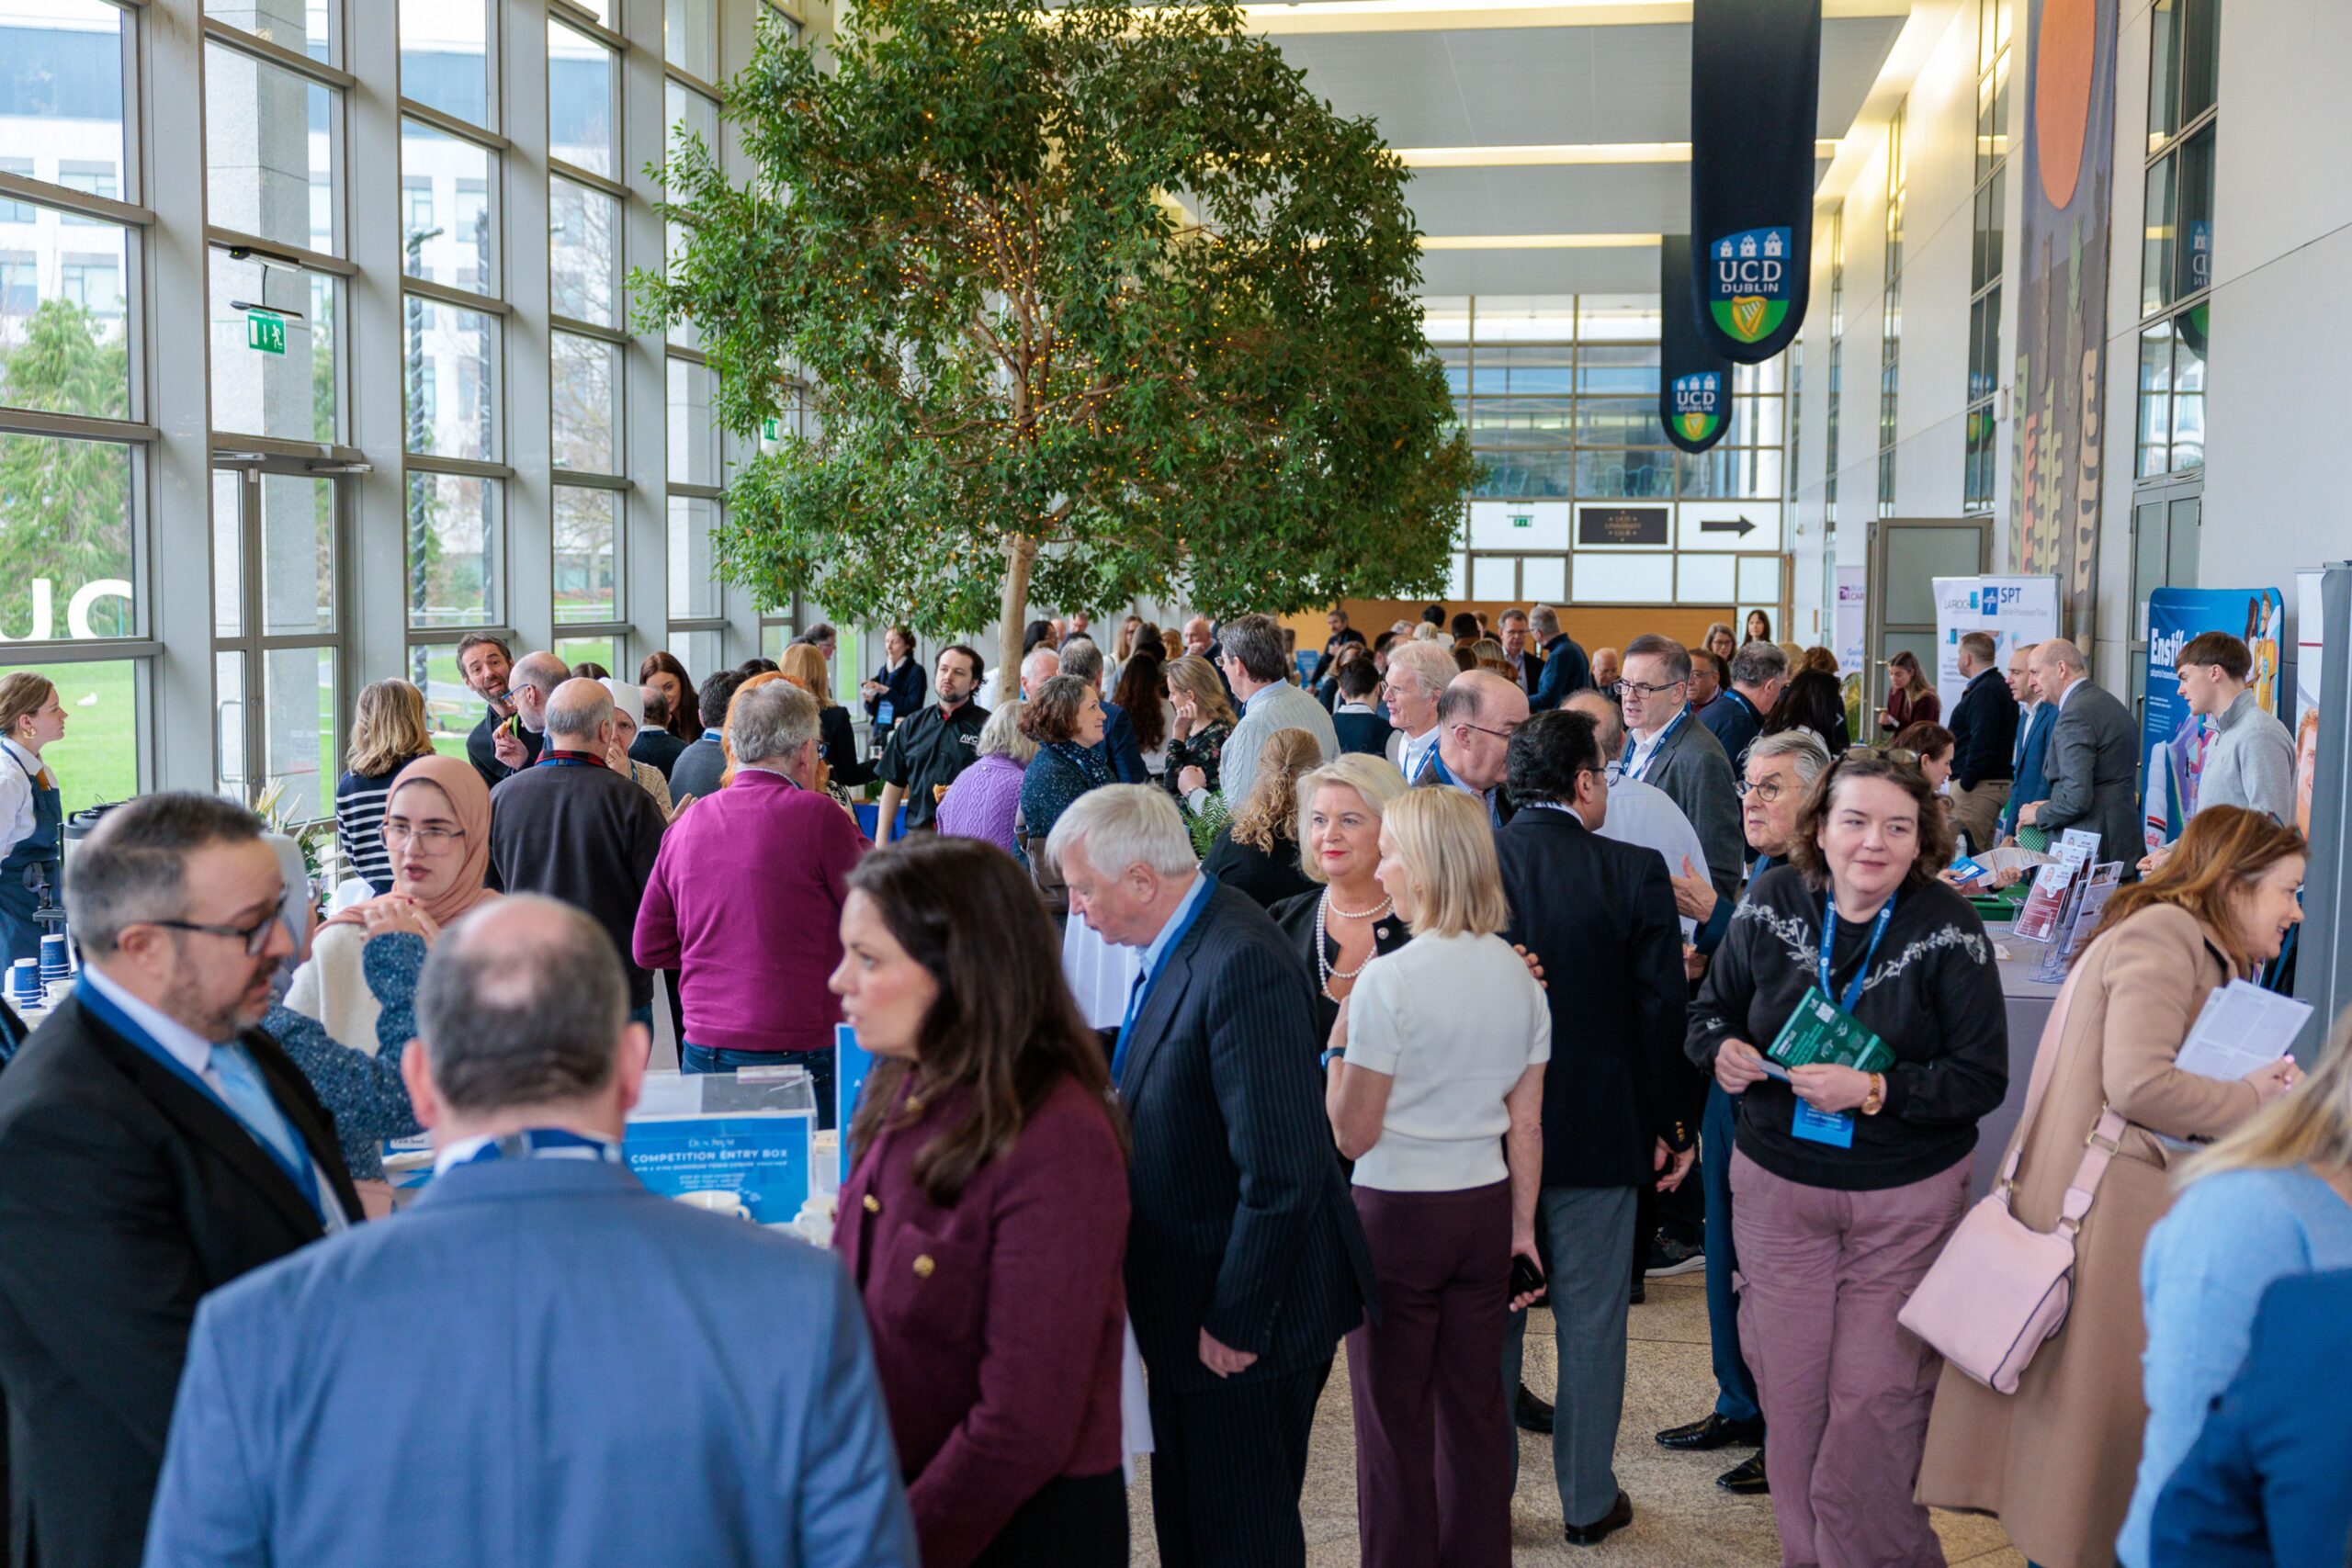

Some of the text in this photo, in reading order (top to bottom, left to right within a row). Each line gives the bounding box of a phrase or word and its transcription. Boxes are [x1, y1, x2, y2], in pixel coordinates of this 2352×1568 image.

[1719, 261, 1781, 282] UCD
[1721, 283, 1779, 293] DUBLIN
[1677, 391, 1715, 405] UCD
[2000, 587, 2021, 604] SPT
[959, 733, 978, 743] AVC
[630, 1148, 787, 1164] COMPETITION ENTRY BOX
